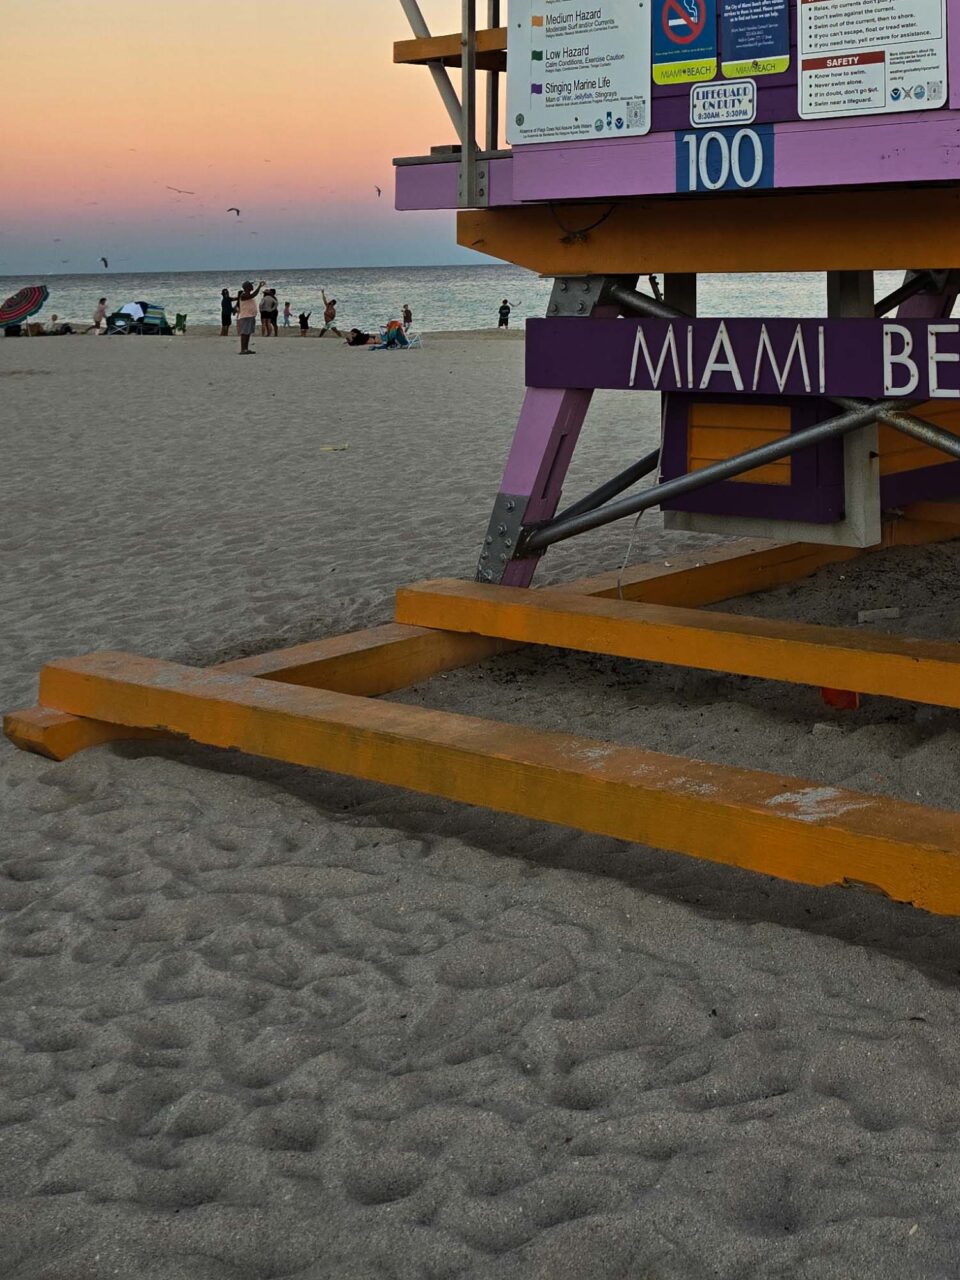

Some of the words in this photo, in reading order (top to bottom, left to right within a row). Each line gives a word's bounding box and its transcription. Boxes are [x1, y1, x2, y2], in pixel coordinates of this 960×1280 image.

[546, 14, 573, 26] Medium
[576, 8, 602, 22] Hazard
[844, 10, 863, 18] against
[546, 50, 560, 60] Low
[562, 45, 589, 58] Hazard
[827, 56, 859, 67] SAFETY
[546, 82, 571, 95] Stinging
[573, 79, 596, 91] Marine
[598, 76, 611, 88] Life
[696, 87, 750, 101] LIFEGUARD
[702, 101, 716, 111] ON
[717, 98, 744, 109] DUTY
[698, 112, 720, 120] 8:30AM
[725, 109, 748, 118] 5:30PM
[682, 128, 763, 190] 100
[628, 320, 825, 393] MIAMI
